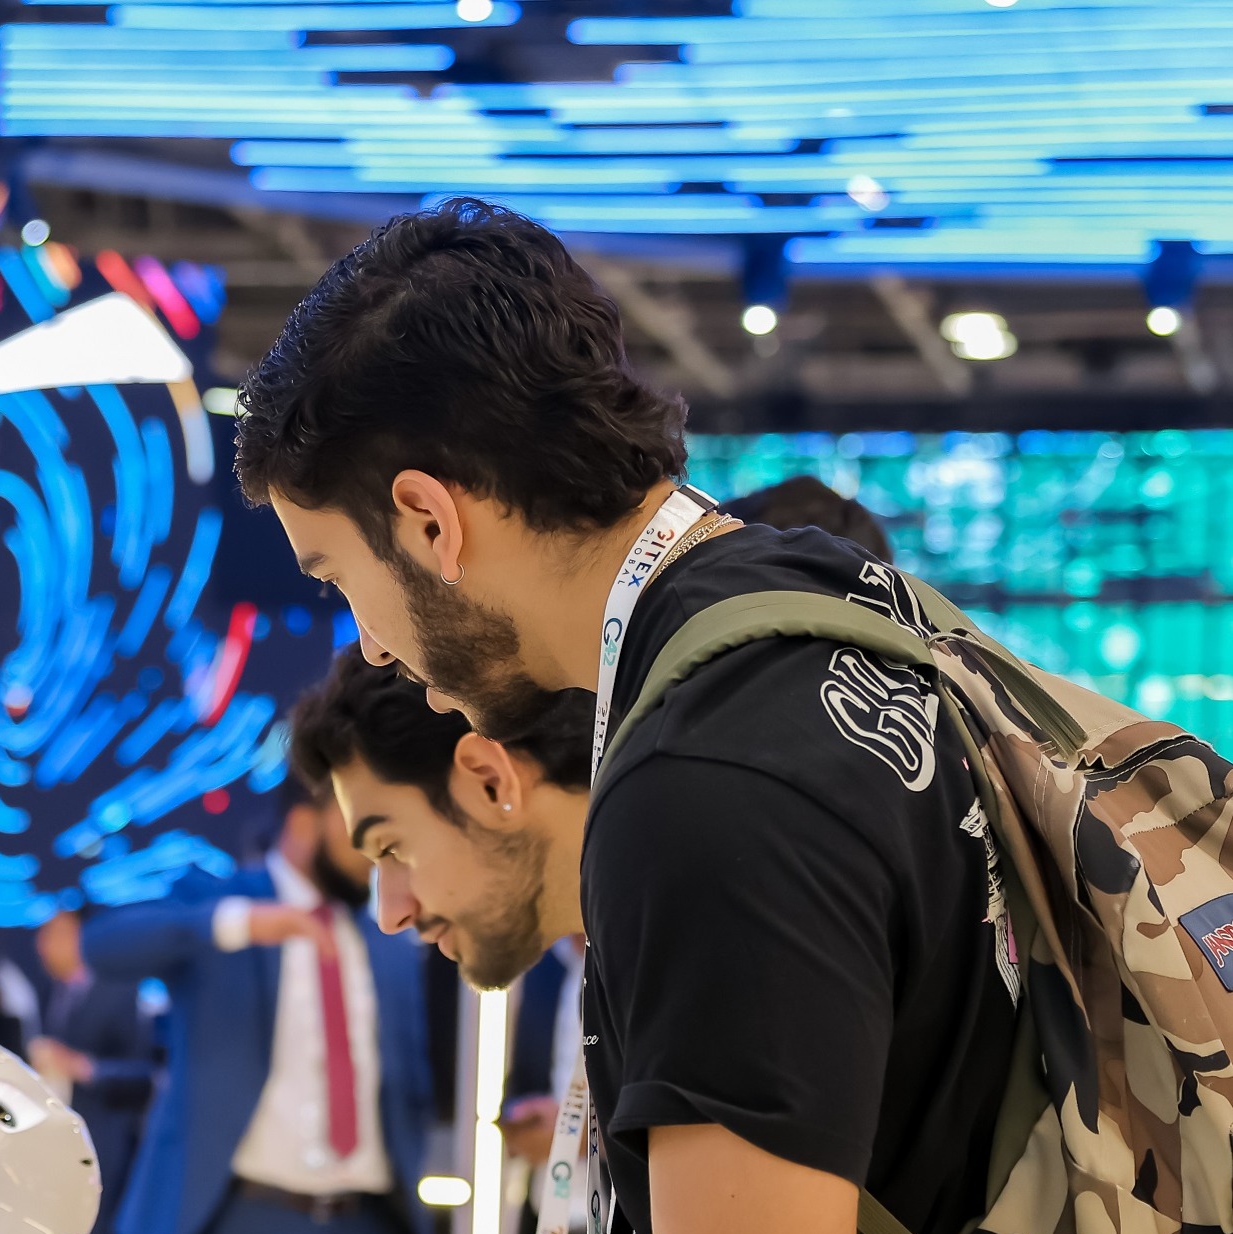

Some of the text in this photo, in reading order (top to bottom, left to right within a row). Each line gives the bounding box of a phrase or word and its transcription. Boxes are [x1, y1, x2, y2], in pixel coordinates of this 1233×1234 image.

[618, 528, 655, 585] GLOBAL
[628, 529, 675, 587] GITEX
[603, 617, 623, 667] G42
